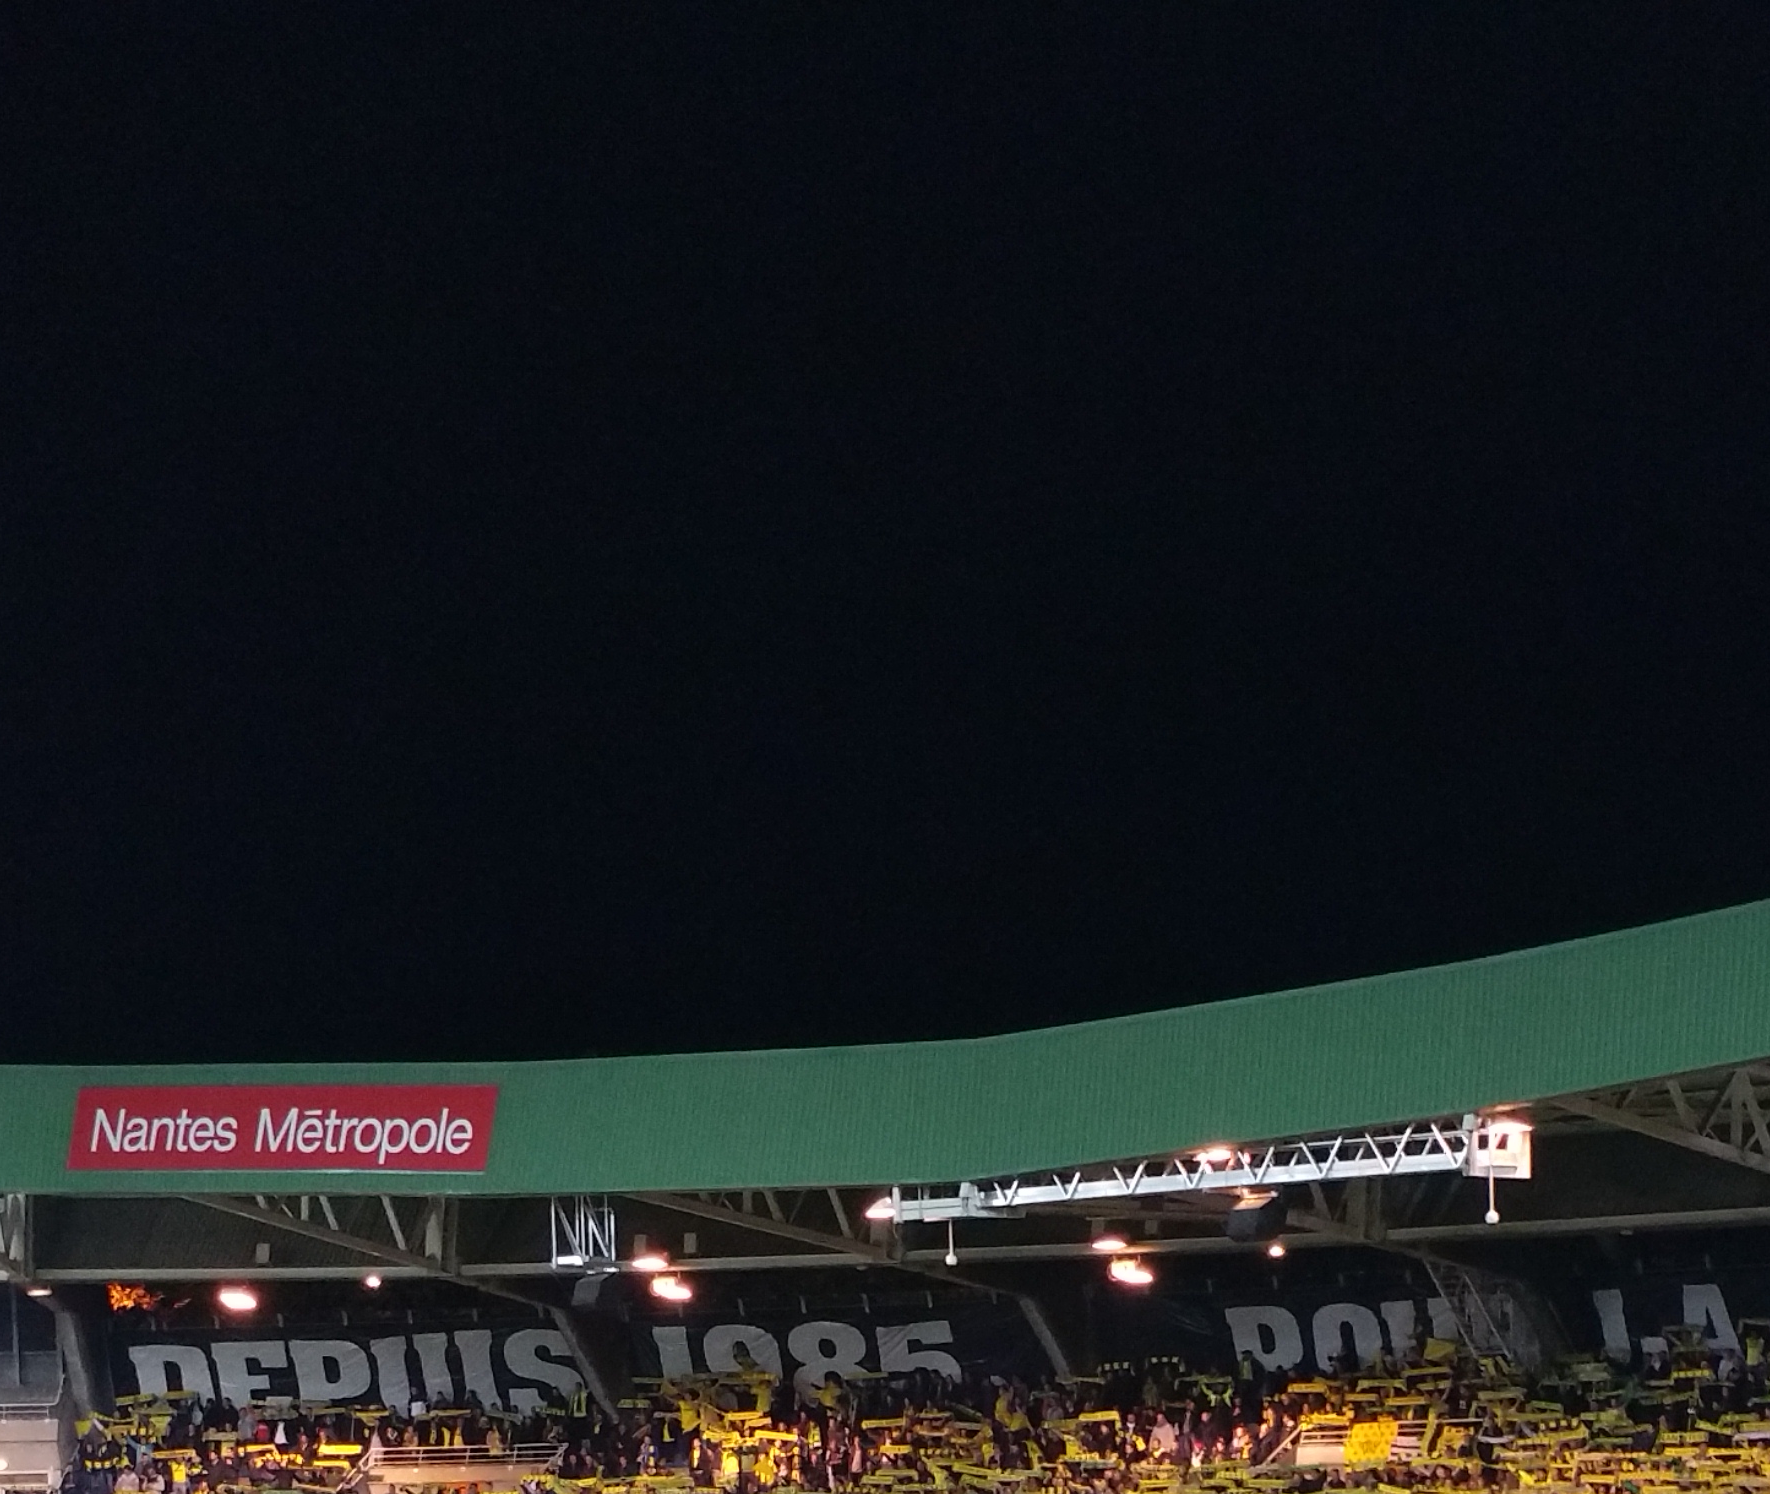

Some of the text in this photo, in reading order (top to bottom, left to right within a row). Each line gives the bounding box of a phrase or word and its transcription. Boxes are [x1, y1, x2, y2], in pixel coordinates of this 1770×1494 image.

[89, 1106, 474, 1165] Nantes Métropole
[127, 1327, 587, 1416] DEPUIS
[650, 1320, 961, 1390] 1985
[1592, 1283, 1745, 1364] LA
